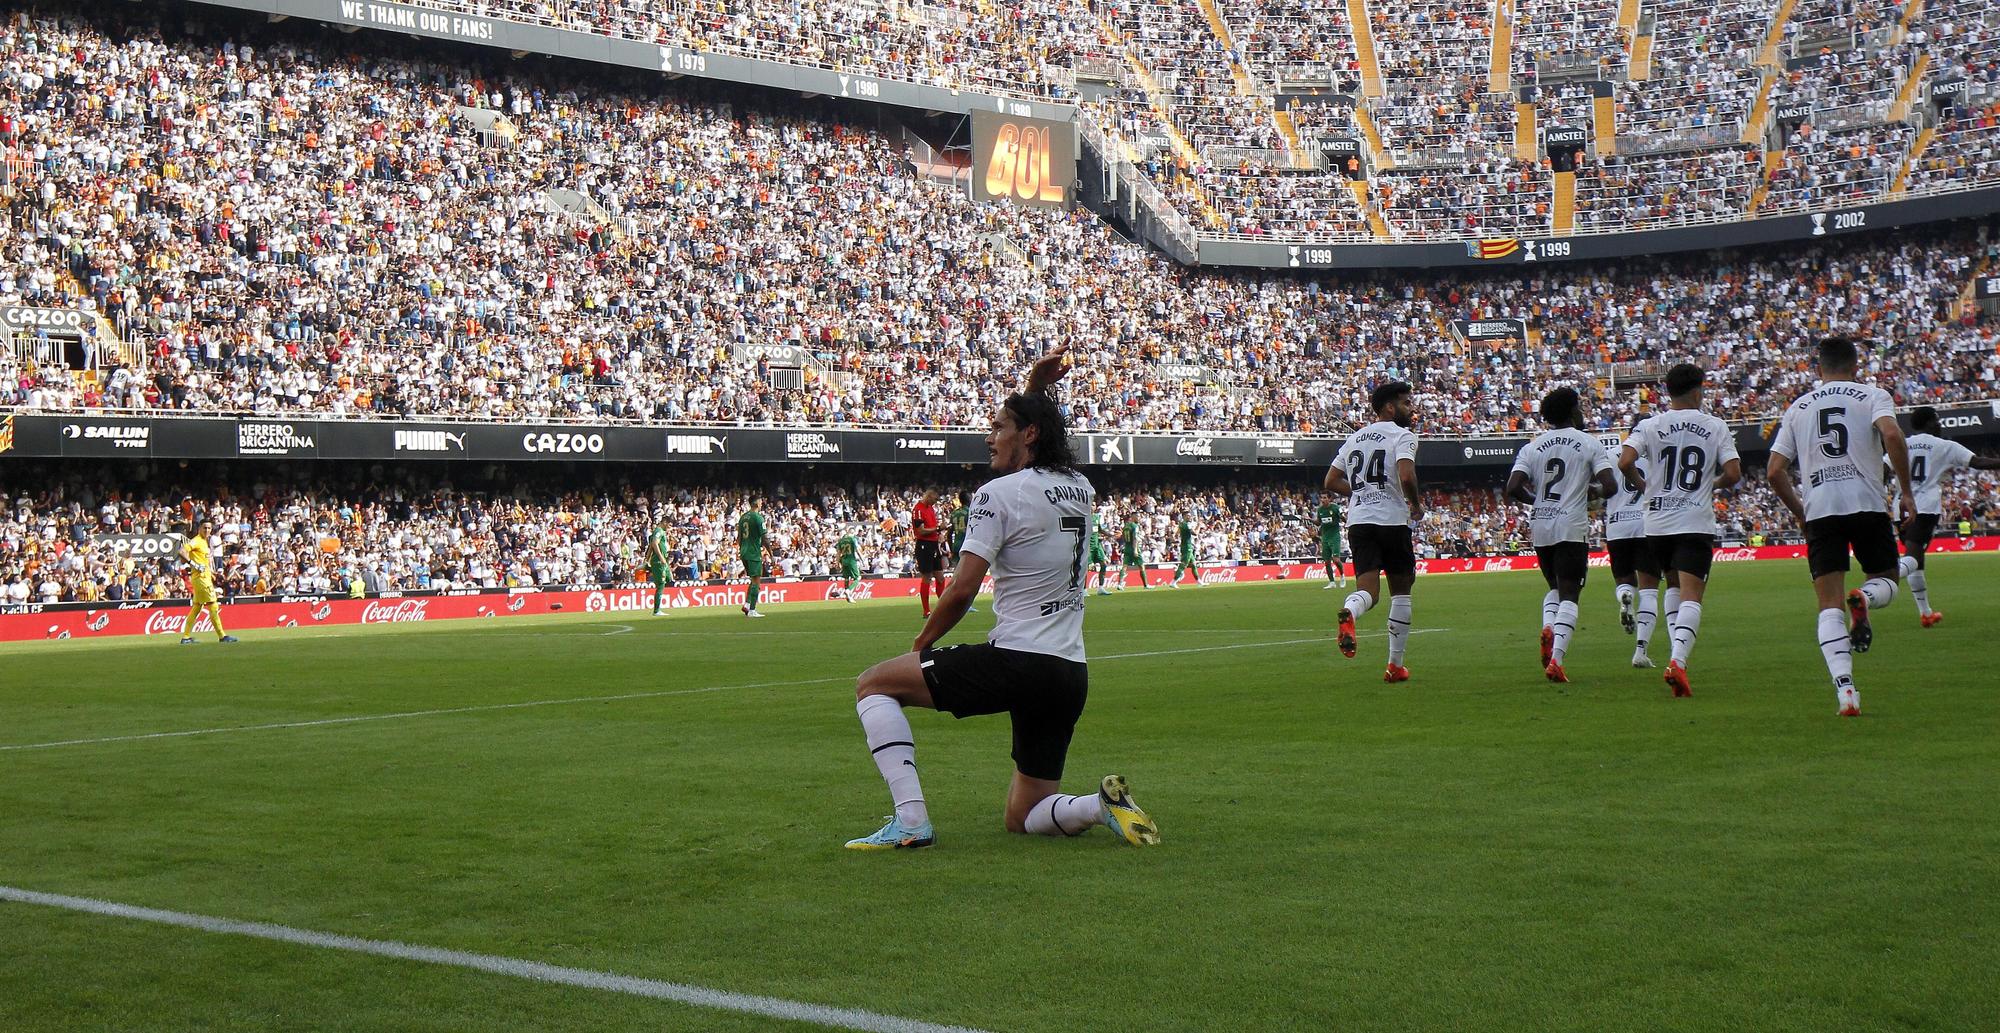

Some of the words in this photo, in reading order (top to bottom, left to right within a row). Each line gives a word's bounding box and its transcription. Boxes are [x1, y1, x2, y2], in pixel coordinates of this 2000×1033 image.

[341, 0, 364, 20] WE
[368, 4, 416, 28] THANK
[419, 12, 449, 33] OUR
[453, 17, 493, 39] FANS!
[678, 53, 706, 72] 1979
[854, 79, 879, 97] 1980
[1932, 81, 1966, 95] AMSTE
[1009, 102, 1032, 117] 1980
[1777, 106, 1810, 118] AMSTE
[1547, 131, 1585, 142] AMSTEL
[1321, 141, 1356, 150] AMSTEL
[986, 123, 1064, 202] GOL
[1834, 211, 1866, 229] 2002
[1304, 249, 1332, 263] 1999
[1540, 242, 1571, 257] 1999
[7, 308, 81, 326] CAZOO
[746, 345, 793, 358] CAZOO
[1167, 365, 1200, 377] CAZOO
[1811, 387, 1868, 402] PAULISTA
[84, 426, 149, 438] SAILUN
[238, 424, 293, 436] HERRERO
[1657, 430, 1669, 440] A.
[1670, 422, 1711, 440] ALMEIDA
[1816, 406, 1849, 459] 5
[239, 435, 314, 447] BRIGANTINA
[395, 430, 448, 450] PUMA
[523, 432, 604, 453] CAZOO
[667, 435, 712, 453] PUMA
[787, 433, 825, 443] HERRERO
[908, 440, 946, 448] SAILUN
[1266, 440, 1294, 448] SAILUN
[1536, 436, 1573, 453] THIERRY
[1572, 439, 1582, 453] R.
[787, 443, 840, 453] BRIGANTINA
[1177, 437, 1213, 456] Coca-Cola
[1347, 449, 1388, 492] 24
[1658, 445, 1706, 492] 18
[1824, 463, 1857, 473] HERRERO
[1541, 457, 1566, 502] 2
[1045, 485, 1089, 506] CAVANI
[1058, 516, 1087, 592] 7
[1713, 548, 1757, 561] Coca-Cola
[1484, 558, 1512, 571] Coca-Cola
[1201, 568, 1237, 583] Coca-Cola
[692, 585, 787, 608] Santader
[362, 599, 429, 624] Coca-Cola
